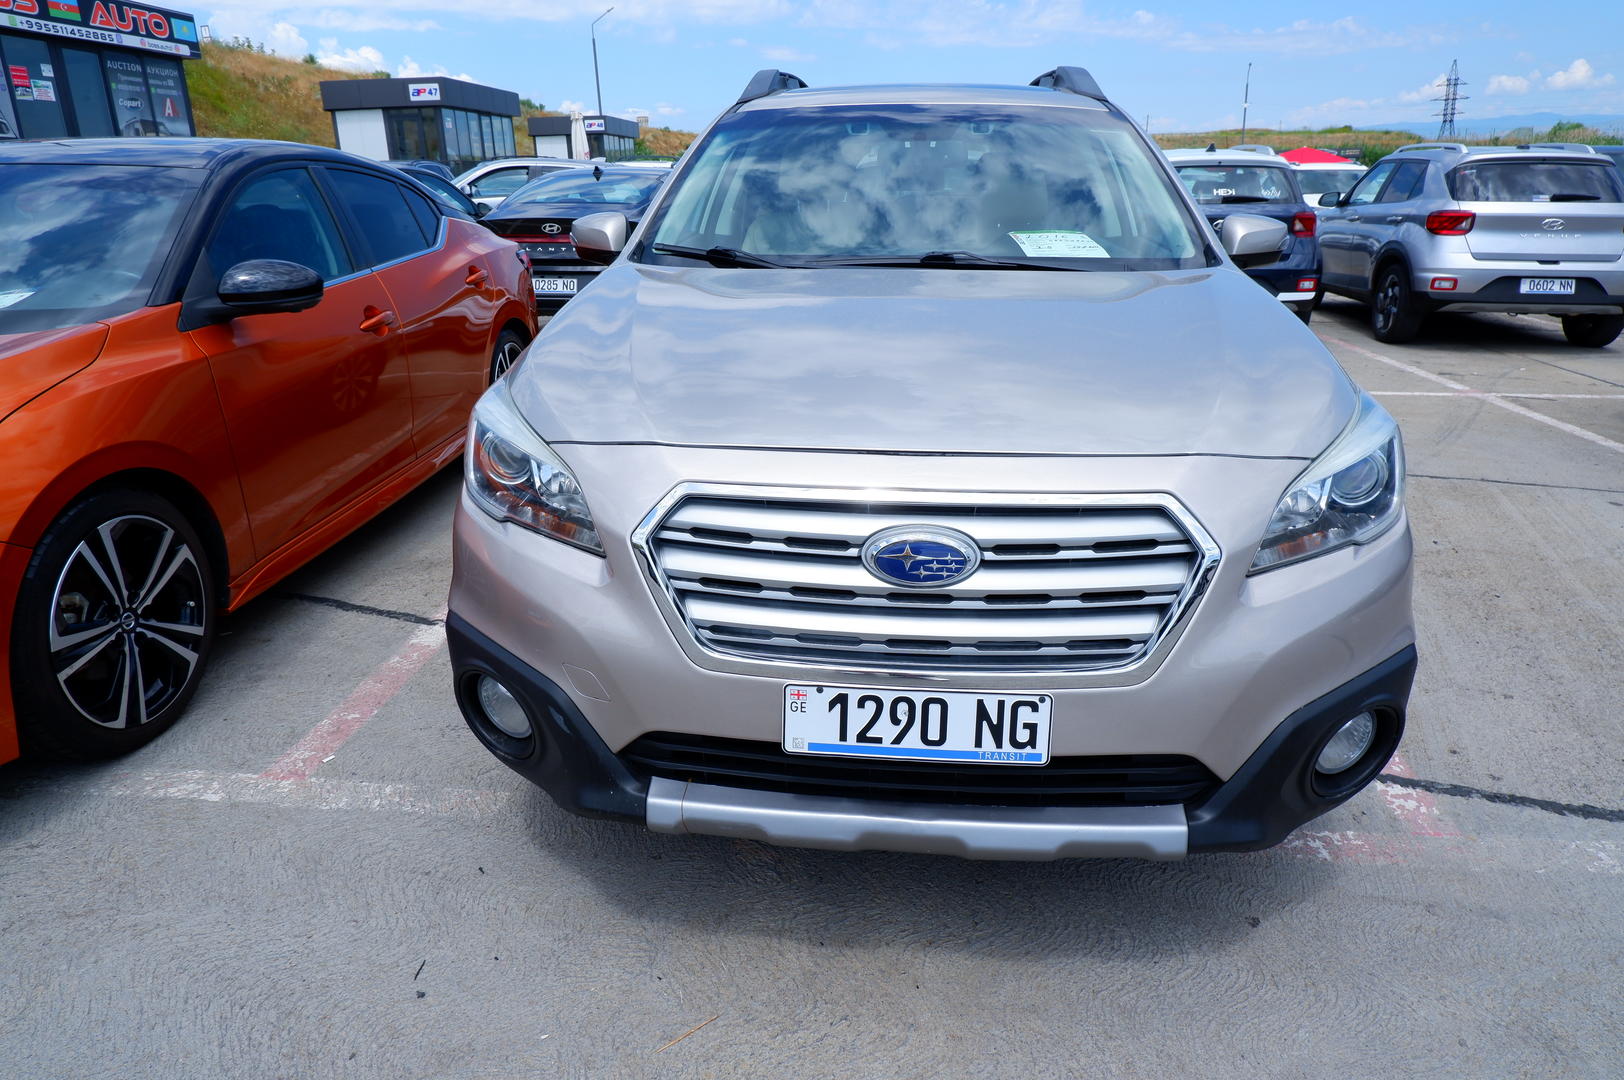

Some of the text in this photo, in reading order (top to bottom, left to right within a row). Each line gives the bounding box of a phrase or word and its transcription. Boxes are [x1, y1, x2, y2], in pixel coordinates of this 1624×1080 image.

[90, 1, 170, 38] AUTO
[19, 19, 114, 42] +995511452885
[107, 60, 142, 72] AUCTION
[428, 88, 438, 96] 47
[119, 98, 142, 108] Copart
[534, 280, 558, 290] 0285
[1529, 280, 1573, 291] 0602 NN
[790, 701, 807, 713] GE
[828, 692, 1040, 750] 1290 NG
[978, 751, 1028, 761] TRANSIT
